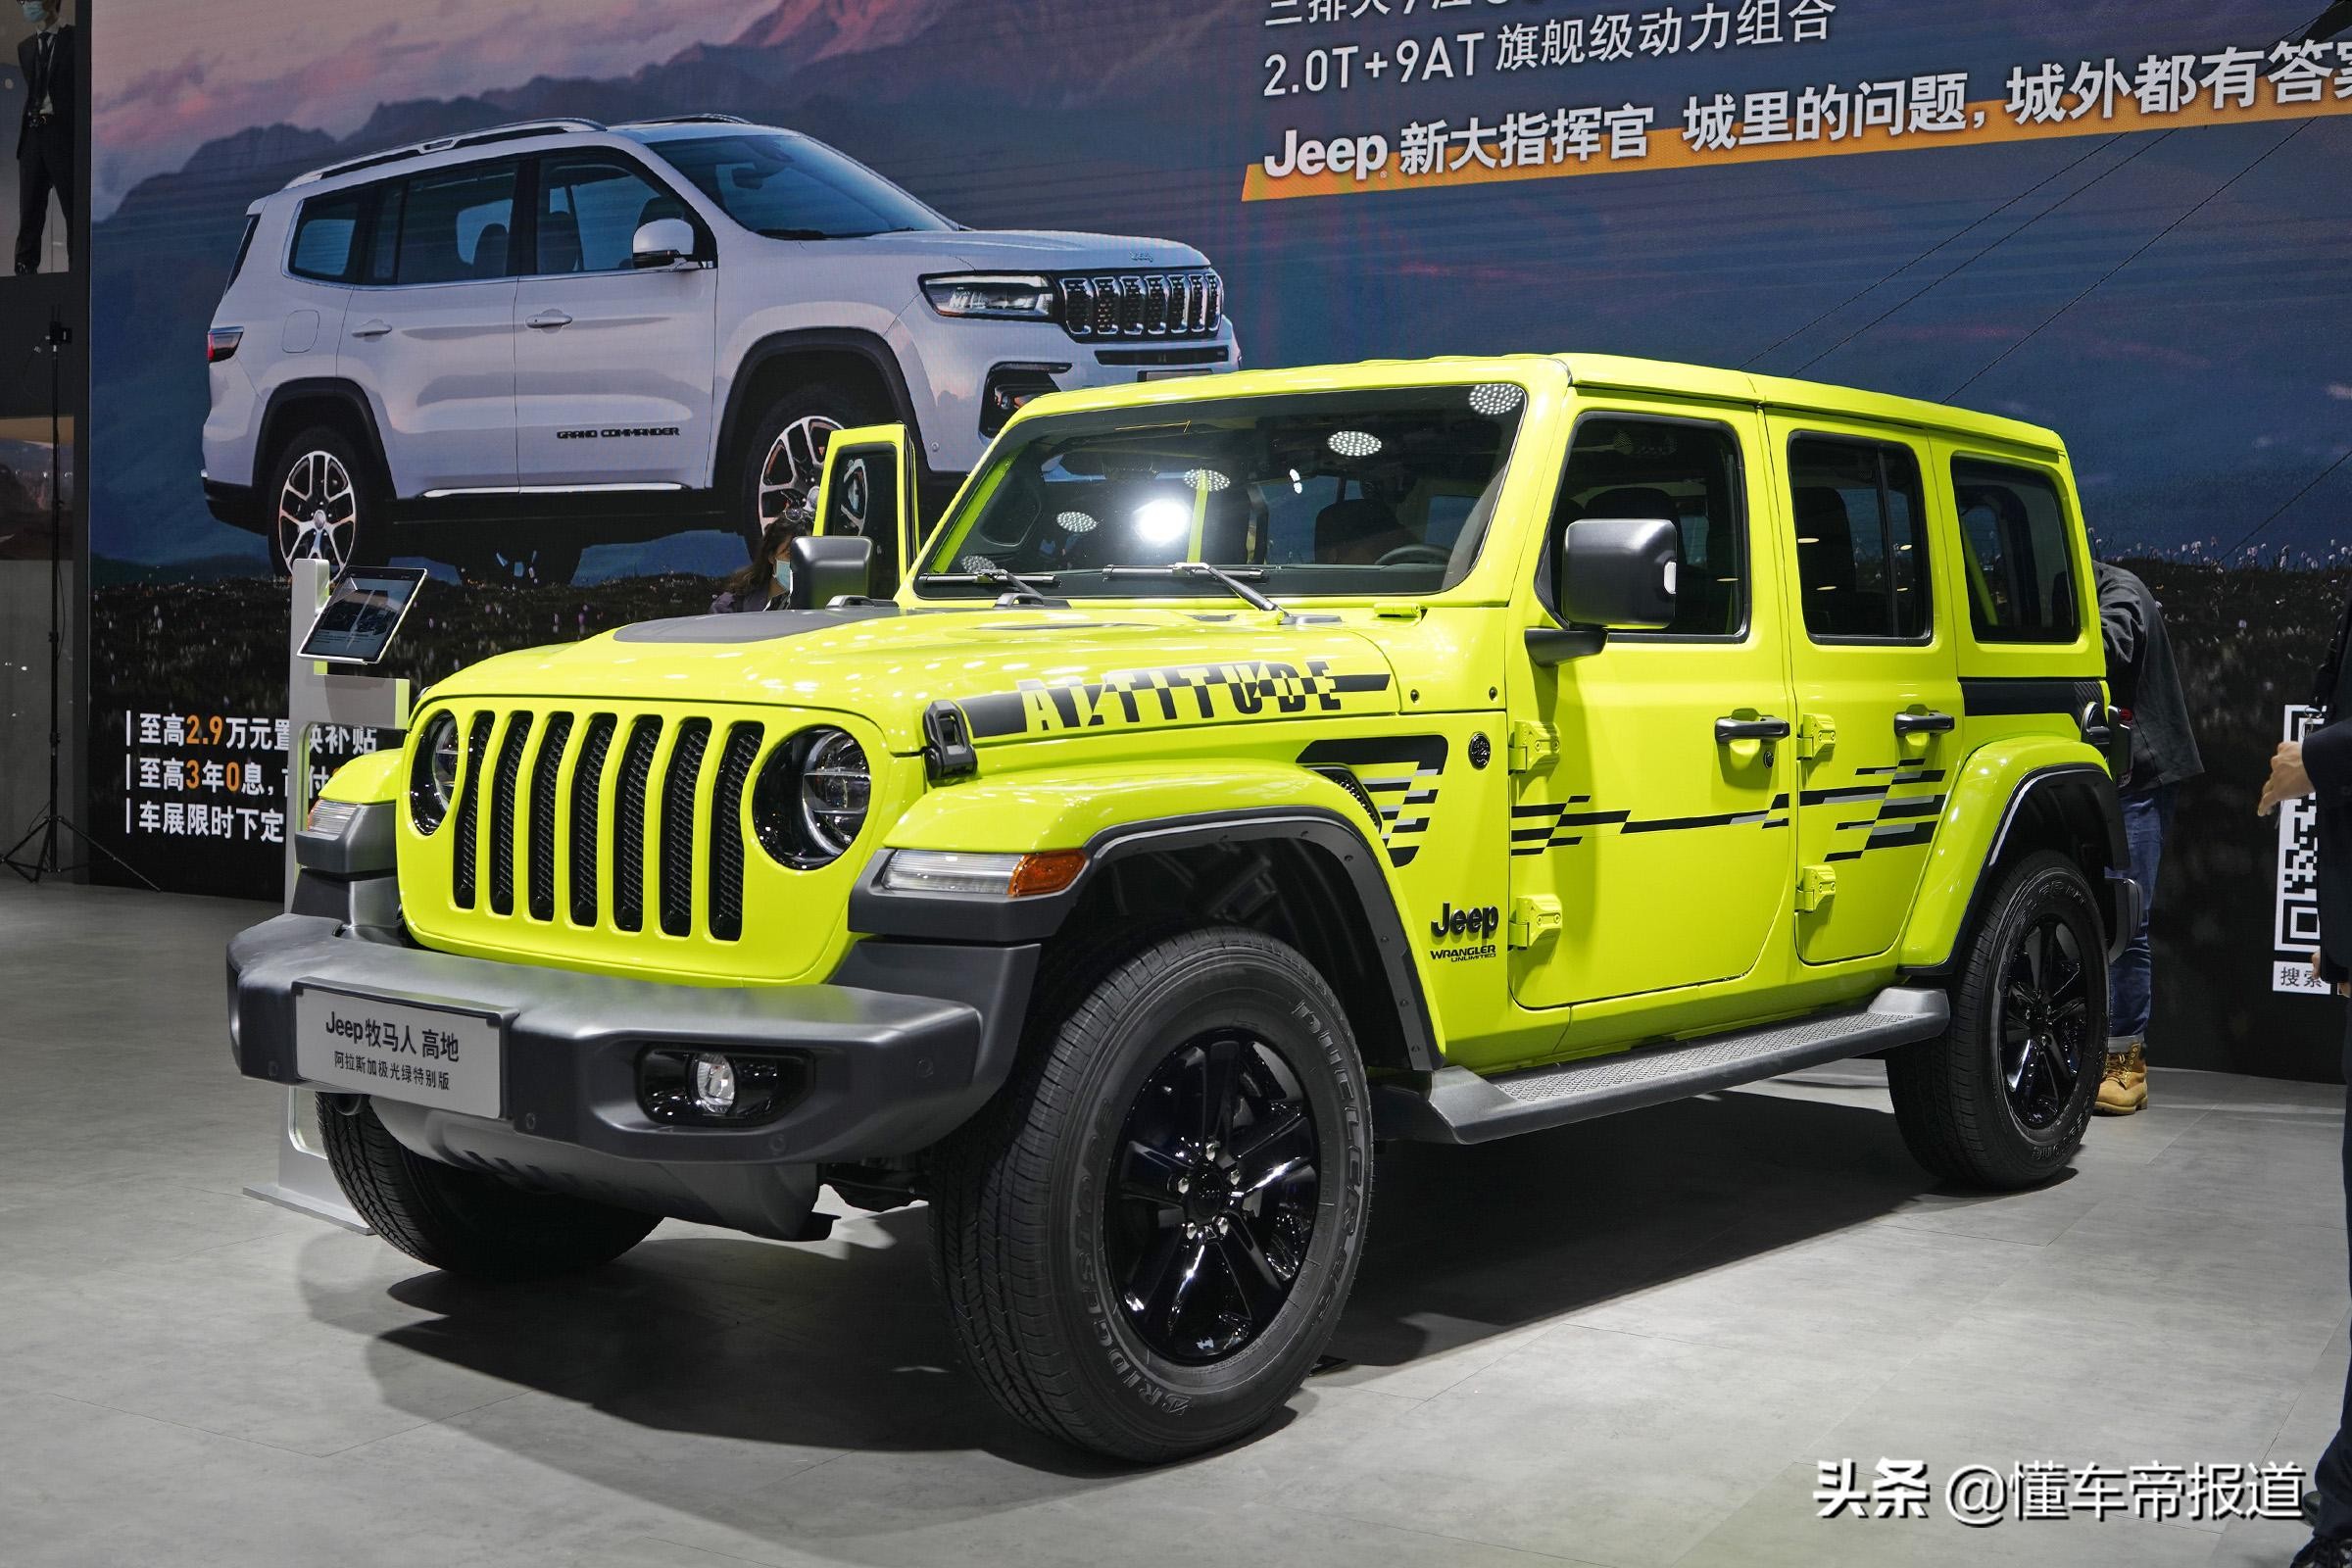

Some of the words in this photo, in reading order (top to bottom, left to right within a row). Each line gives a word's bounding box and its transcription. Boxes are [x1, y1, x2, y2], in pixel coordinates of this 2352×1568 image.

[1263, 32, 1485, 96] 2.0T+9AT
[1496, 0, 1836, 72] 旗舰级动力组合
[1264, 127, 1389, 180] Jeep
[1399, 103, 1654, 175] 新大指挥官
[601, 427, 680, 438] COMMANDER
[1015, 661, 1342, 732] ALTITUDE
[139, 801, 284, 843] 车展限时下定
[1431, 903, 1498, 939] Jeep
[1430, 944, 1496, 959] WRANGLER
[1451, 954, 1496, 962] UNLIMITED
[421, 1029, 460, 1062] 高地
[334, 1051, 451, 1090] 阿拉斯加极光绿特别版
